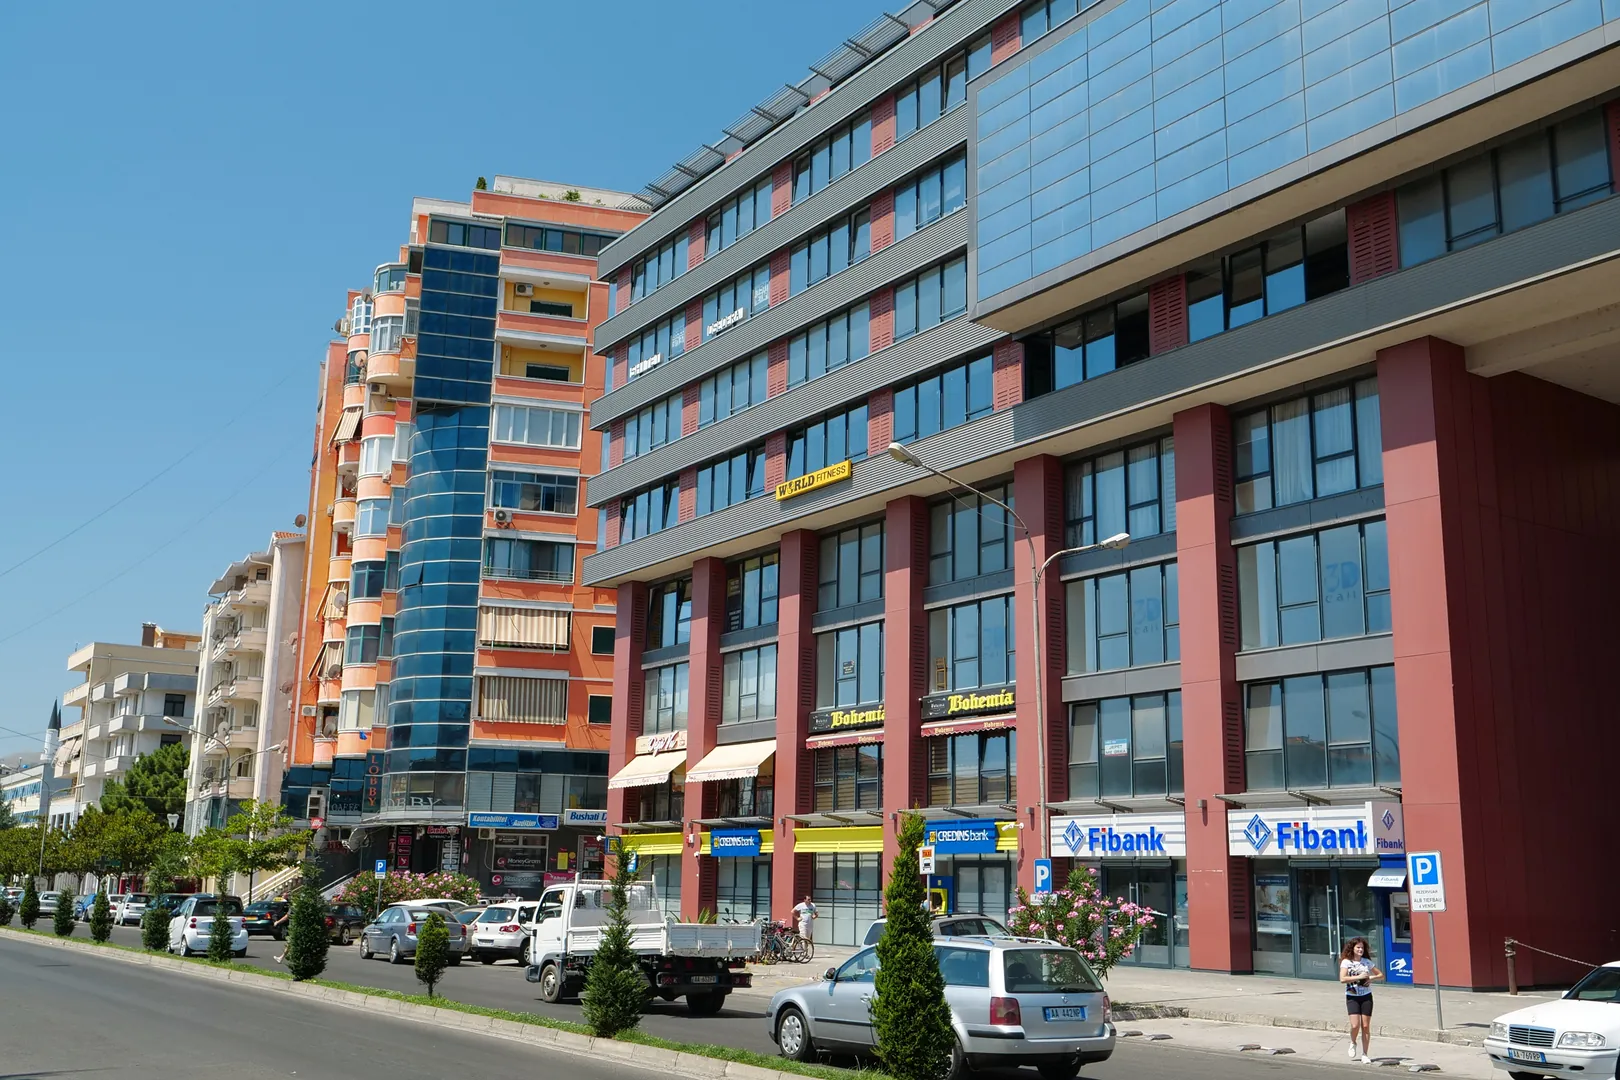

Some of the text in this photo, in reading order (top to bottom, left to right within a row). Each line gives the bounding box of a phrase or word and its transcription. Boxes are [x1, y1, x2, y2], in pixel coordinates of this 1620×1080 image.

[816, 464, 846, 483] FITNESS
[948, 688, 1015, 715] Bohemia
[369, 755, 380, 806] LOBBY
[569, 811, 600, 821] Bushati
[937, 829, 989, 842] CREDINS bank
[1088, 826, 1165, 852] Fibank
[1376, 837, 1404, 849] Fibank
[1036, 865, 1049, 888] P
[1415, 857, 1432, 883] P
[1051, 1009, 1059, 1018] AA
